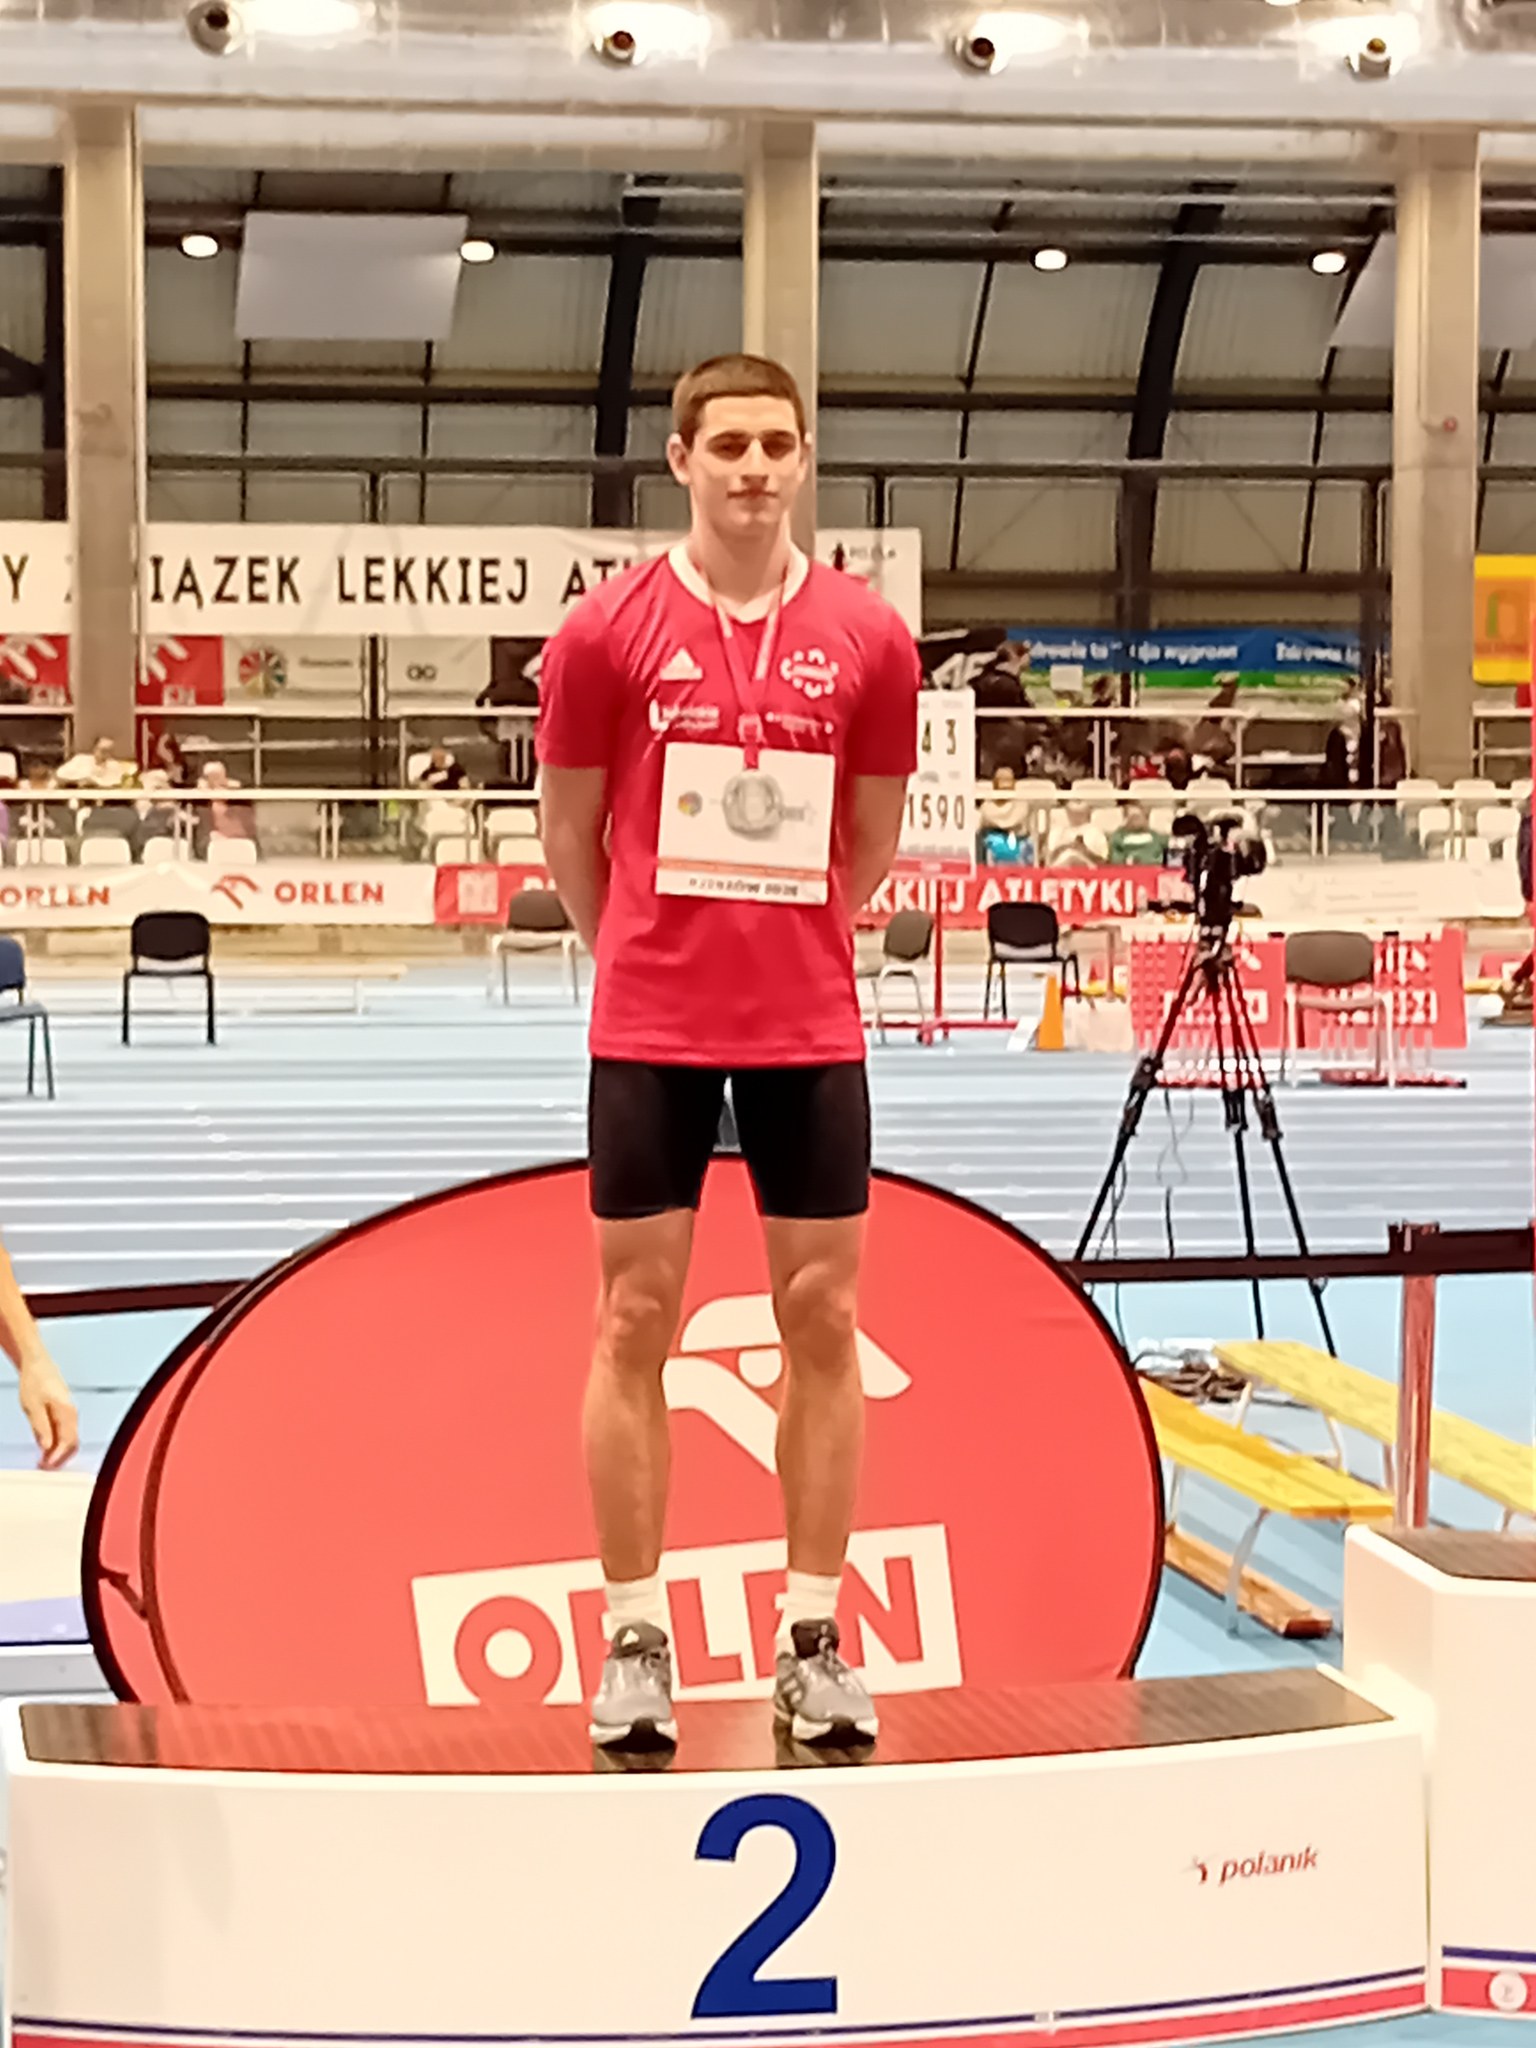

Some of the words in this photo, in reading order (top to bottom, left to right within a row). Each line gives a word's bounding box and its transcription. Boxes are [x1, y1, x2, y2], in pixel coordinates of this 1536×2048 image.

[2, 554, 29, 602] Y
[338, 556, 528, 604] LEKKIEJ
[560, 556, 632, 604] AT
[908, 793, 965, 830] 1590
[0, 885, 110, 908] ORLEN
[274, 881, 384, 905] ORLEN
[1219, 1845, 1318, 1886] polanik
[690, 1793, 838, 2020] 2
